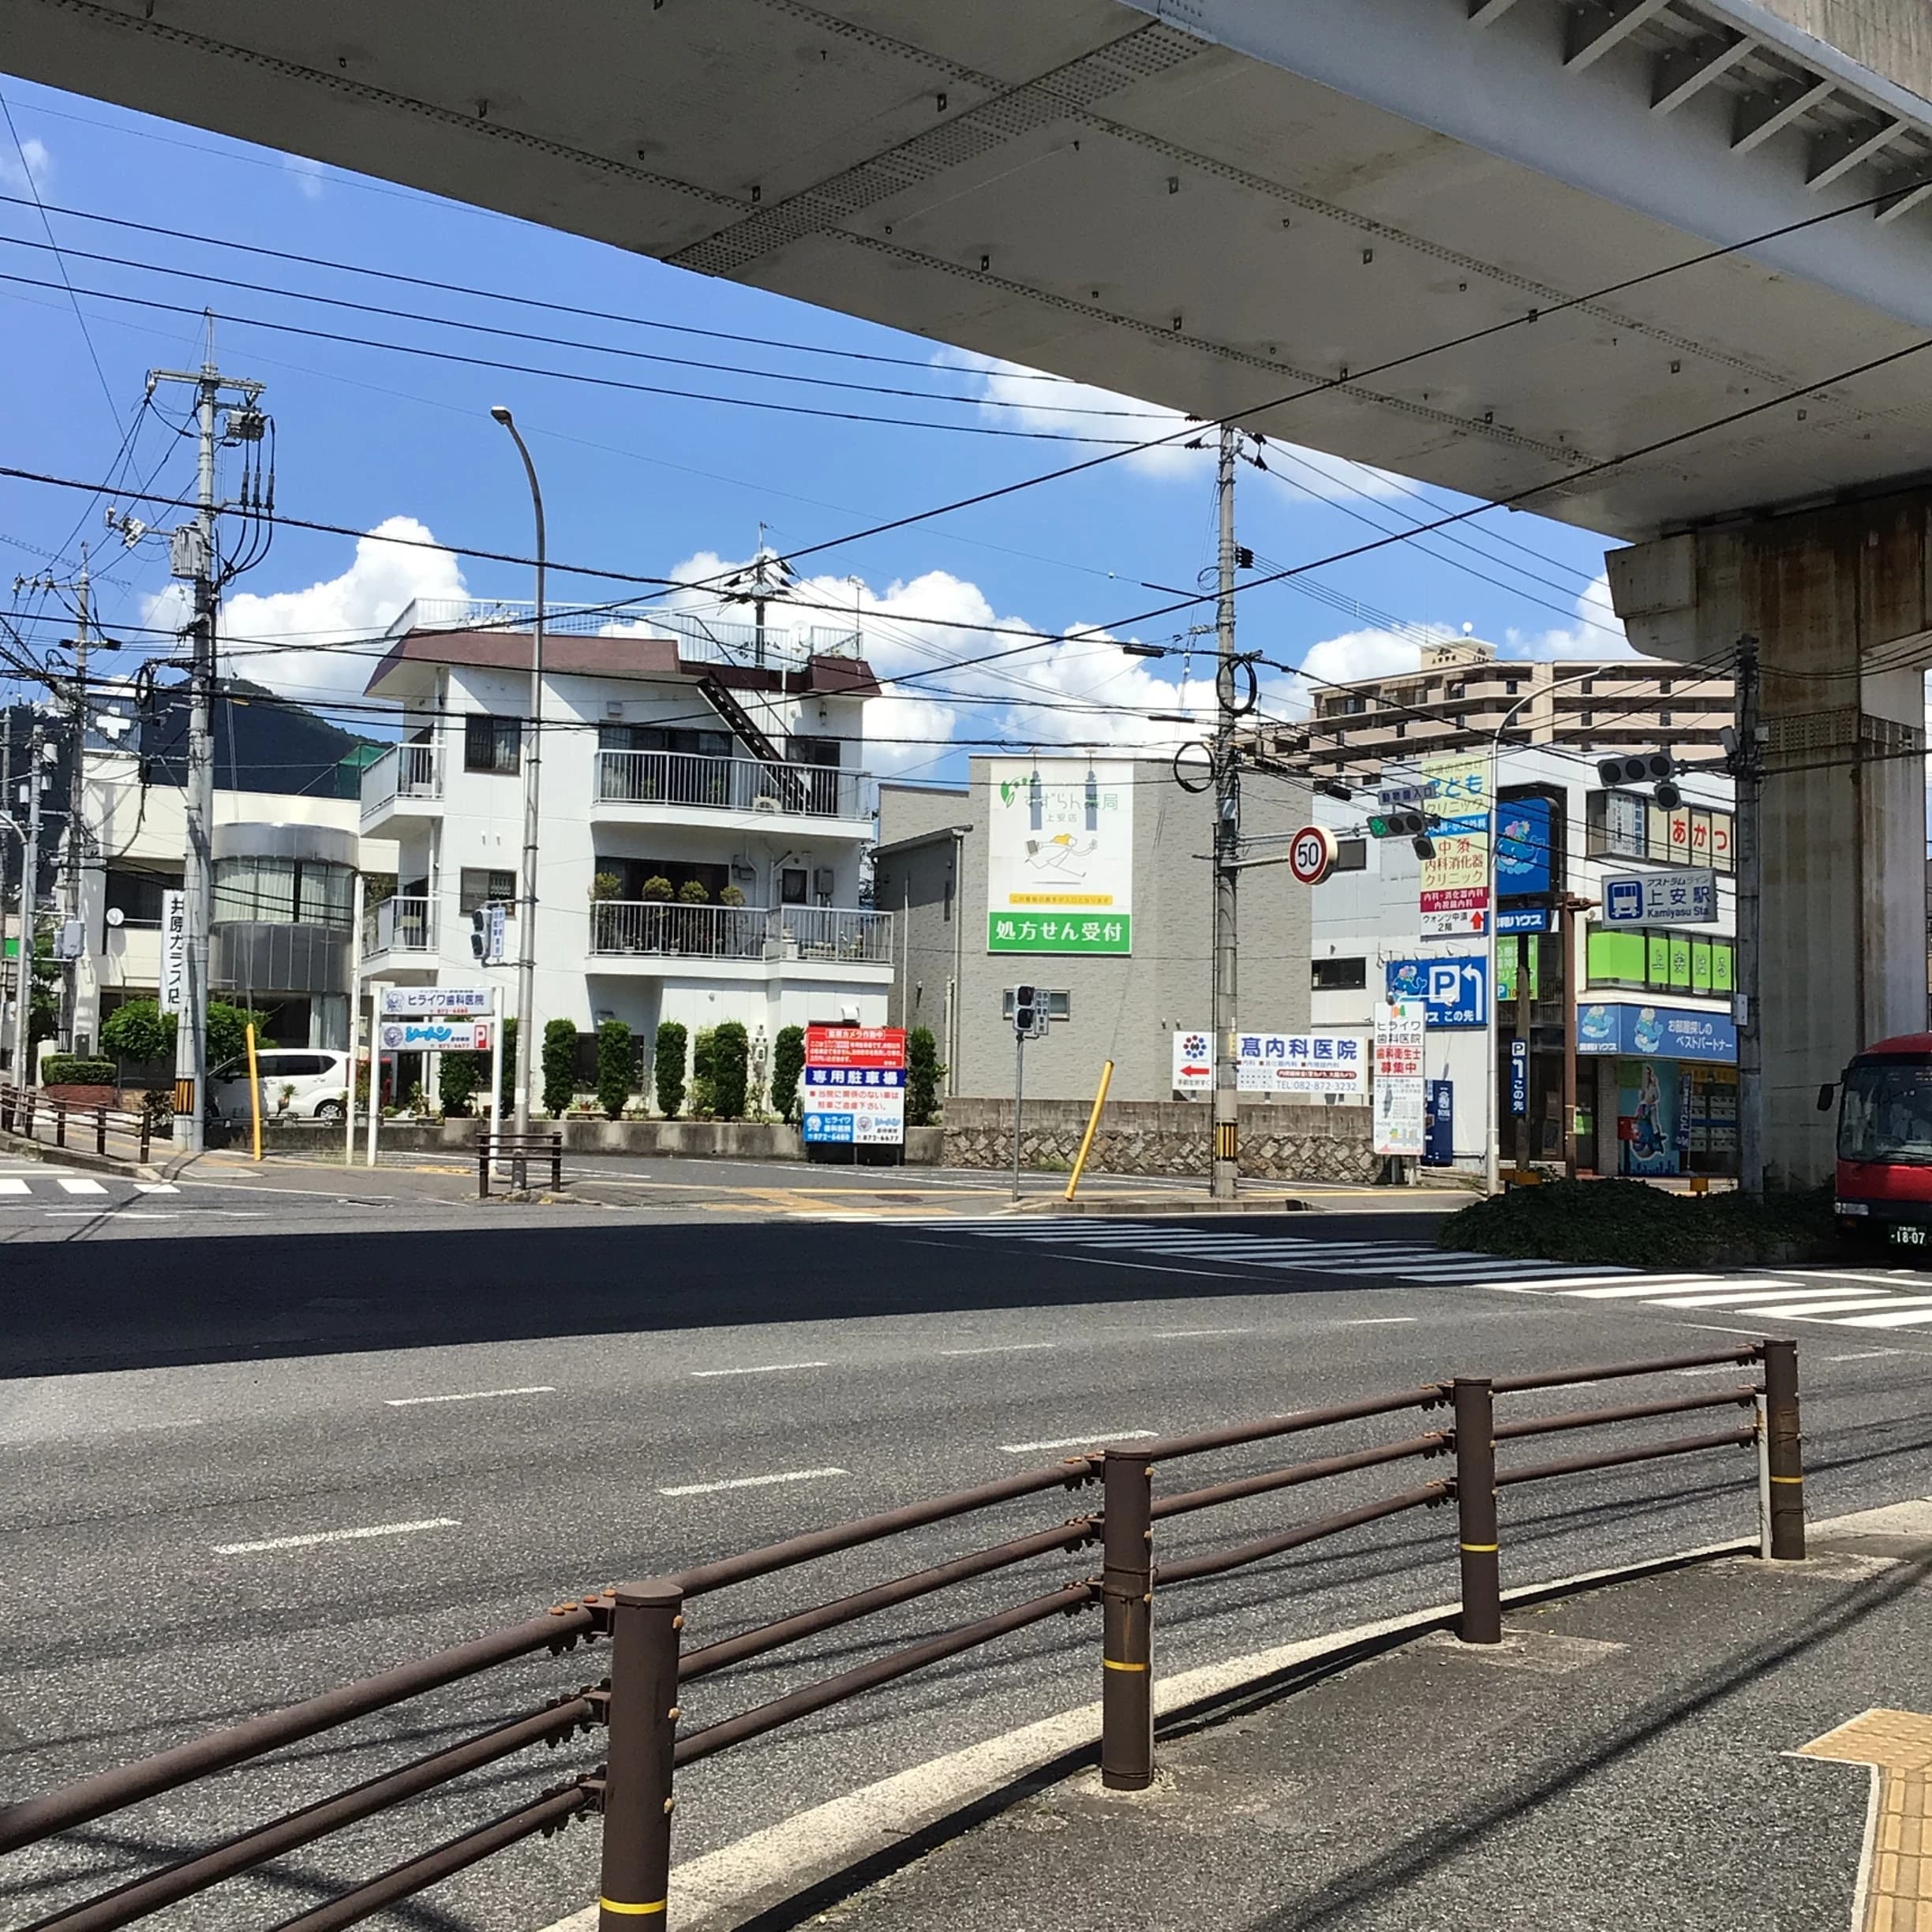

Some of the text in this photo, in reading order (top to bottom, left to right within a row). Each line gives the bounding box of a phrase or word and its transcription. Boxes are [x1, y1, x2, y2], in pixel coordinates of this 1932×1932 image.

[1046, 814, 1077, 822] 上安店
[1298, 842, 1319, 867] 50
[1425, 854, 1483, 871] 内科消化器
[1425, 871, 1483, 887] クリニック
[1647, 875, 1709, 887] アストラムライン
[1647, 886, 1711, 906] 上安駅
[1647, 908, 1692, 919] Kamiyasu
[996, 921, 1122, 942] 処方せん受付
[1438, 923, 1452, 932] 2階
[1435, 972, 1456, 996] P
[408, 994, 485, 1006] ヒライワ歯科医院
[1444, 1009, 1474, 1022] この先
[1377, 1021, 1421, 1031] ヒライワ
[406, 1026, 452, 1043] シートン
[476, 1026, 486, 1048] P
[1377, 1033, 1421, 1044] 歯科医院
[1514, 1043, 1523, 1054] P
[1676, 1035, 1733, 1051] ベストパートナー
[1376, 1048, 1421, 1060] 歯科衛生士
[1380, 1062, 1417, 1074] 募集中
[812, 1070, 898, 1085] 専用駐車場
[1513, 1080, 1523, 1111] この先
